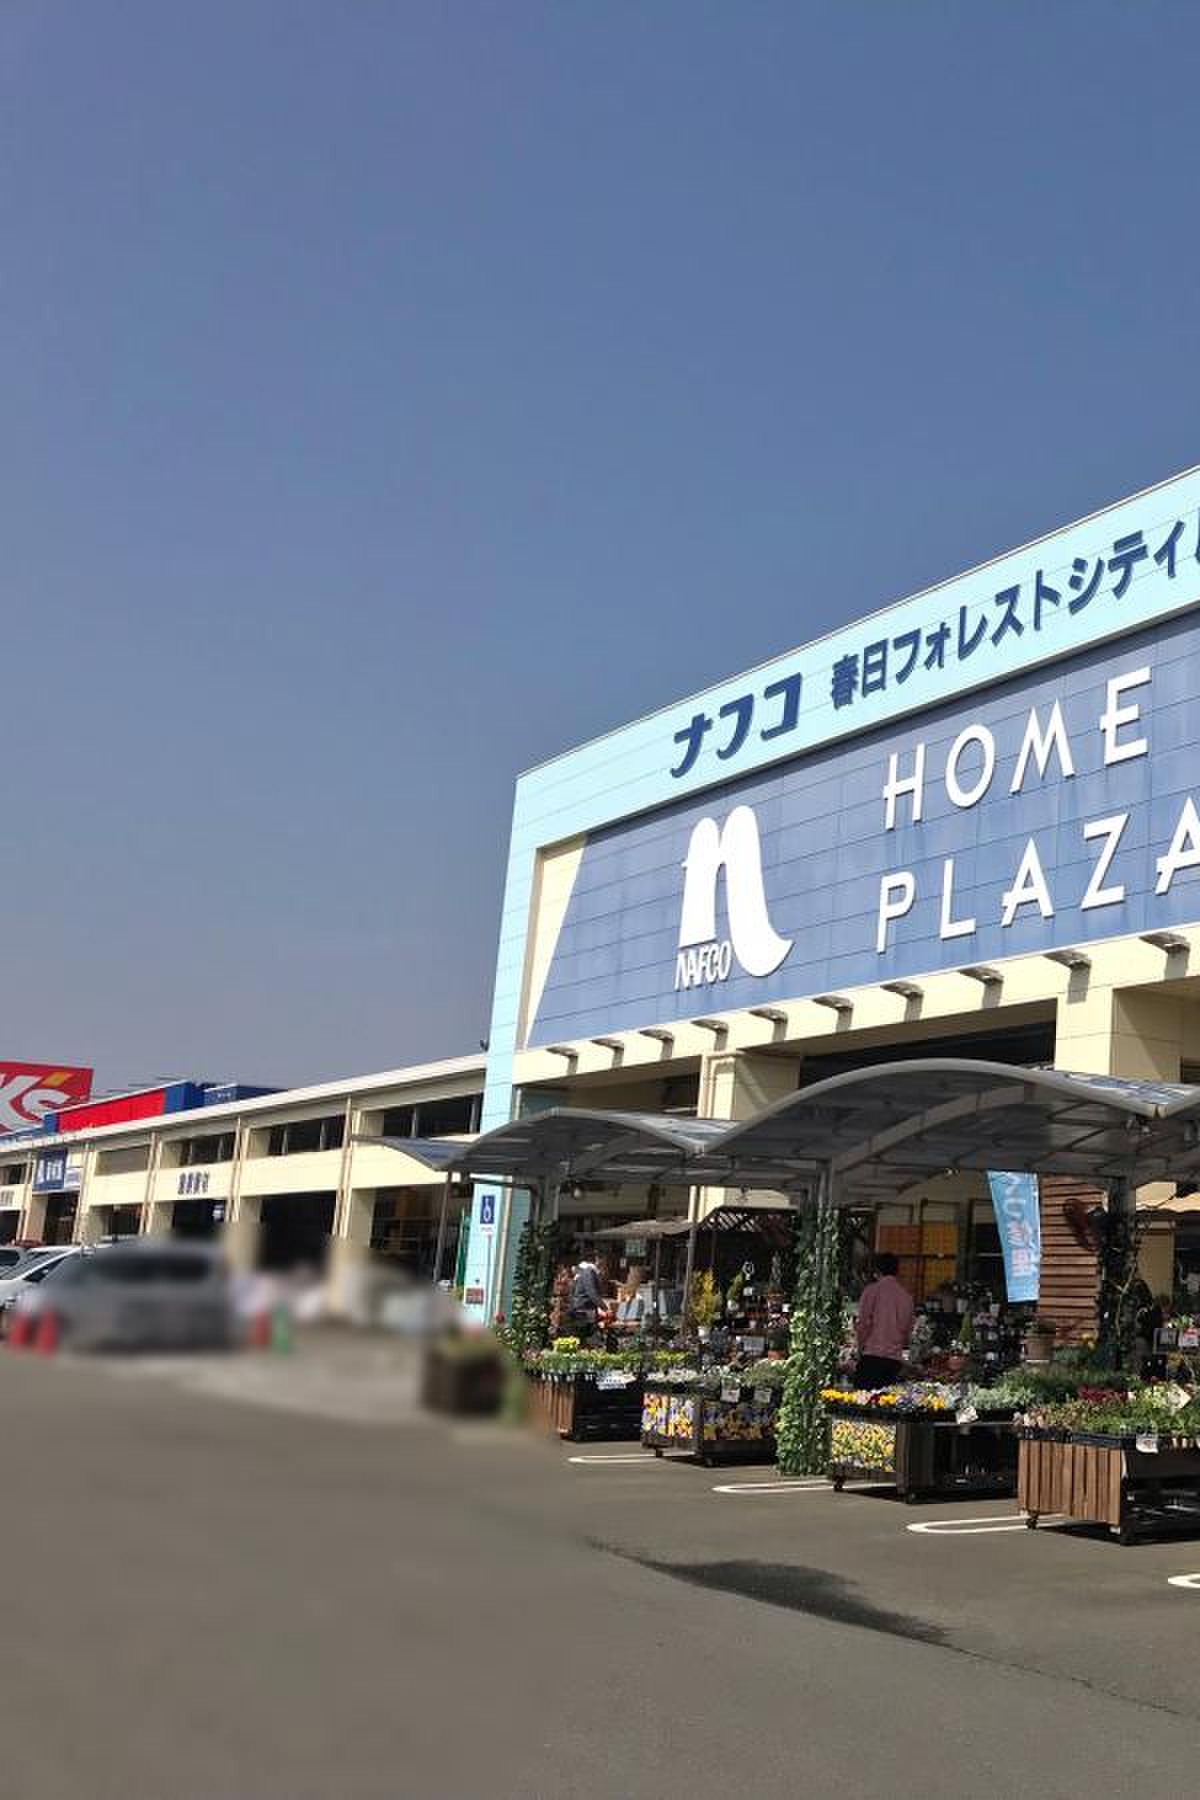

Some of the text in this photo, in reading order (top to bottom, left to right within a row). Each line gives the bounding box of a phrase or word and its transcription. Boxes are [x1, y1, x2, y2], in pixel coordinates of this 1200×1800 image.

[671, 672, 803, 779] ナフコ
[882, 666, 1151, 830] HOME
[674, 940, 732, 992] NAFCO
